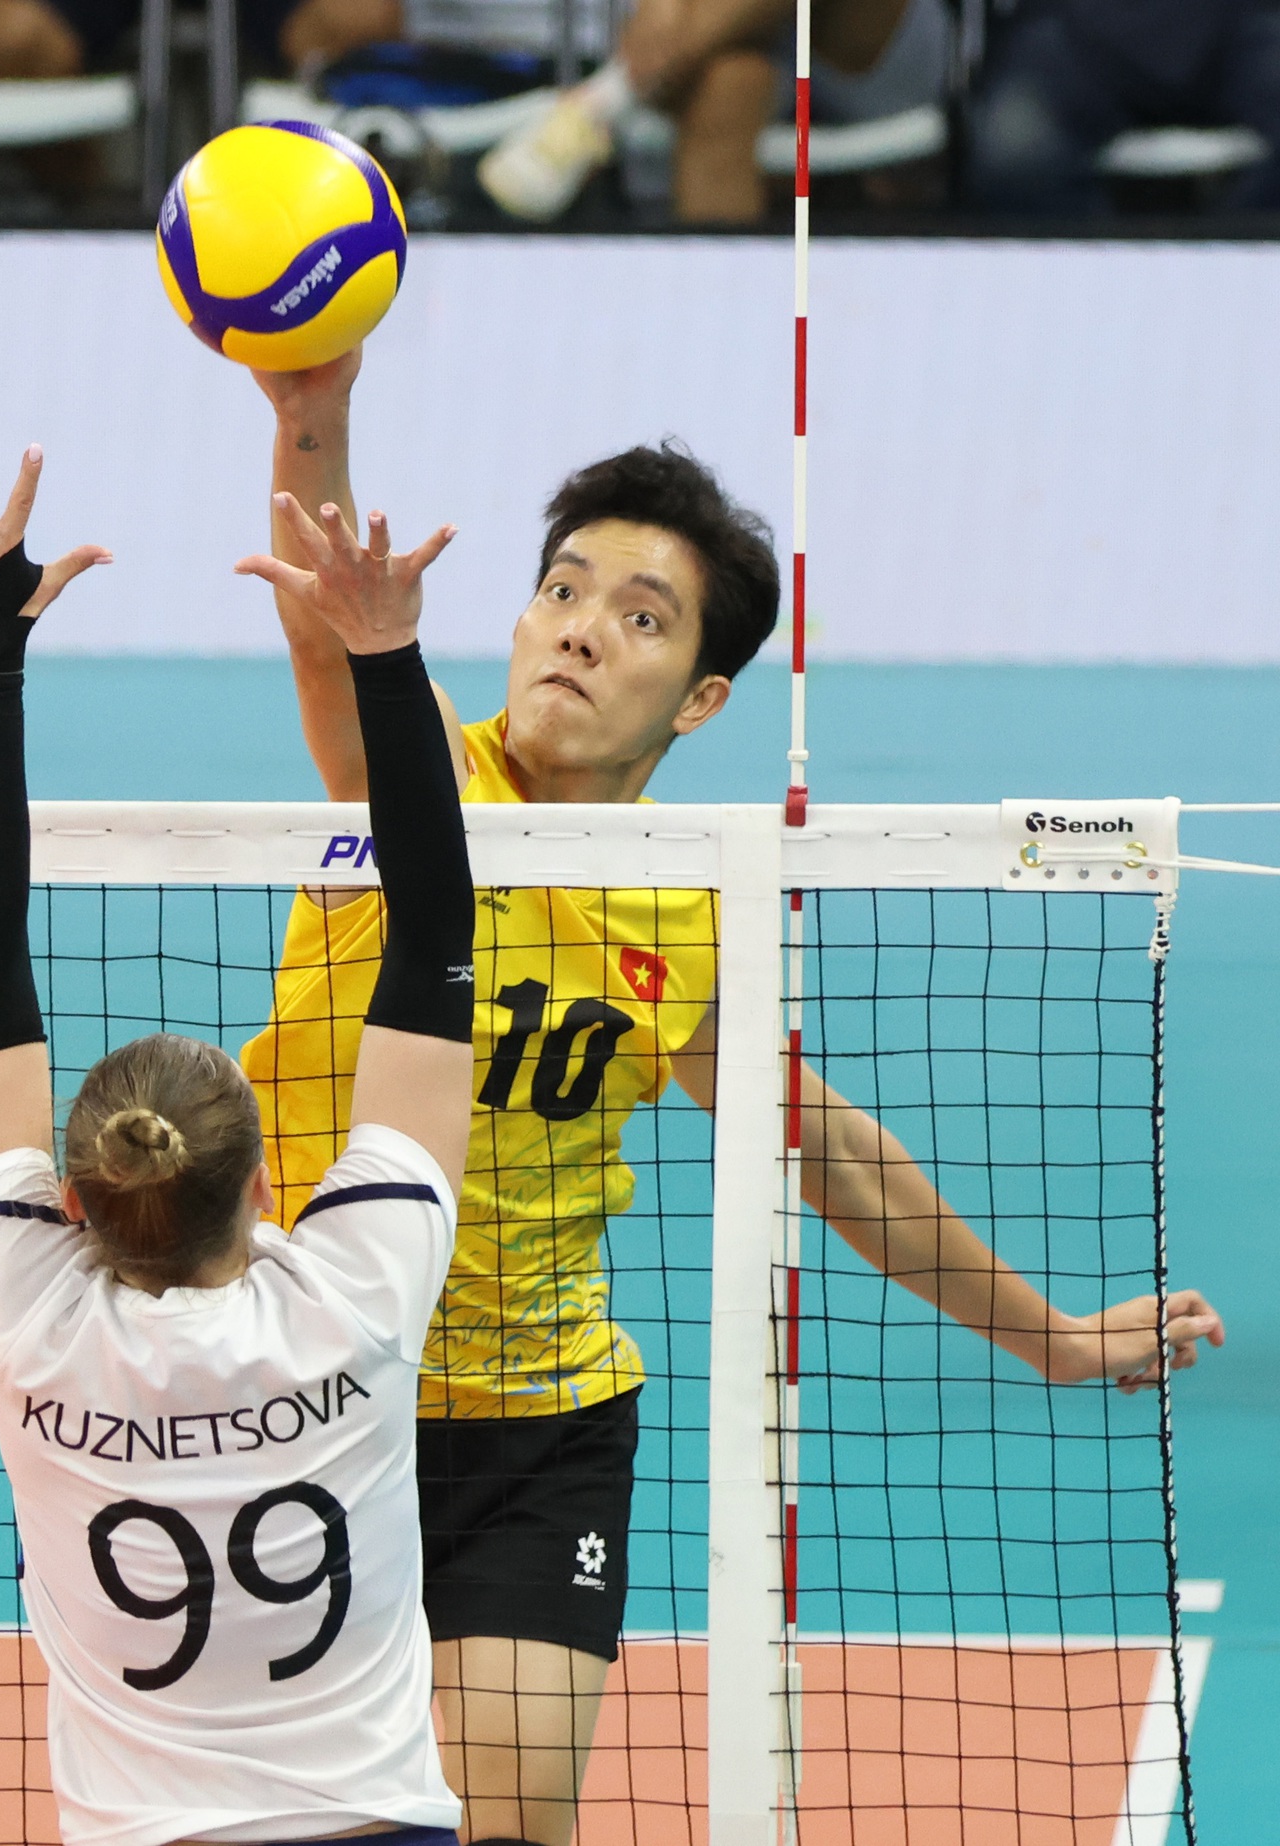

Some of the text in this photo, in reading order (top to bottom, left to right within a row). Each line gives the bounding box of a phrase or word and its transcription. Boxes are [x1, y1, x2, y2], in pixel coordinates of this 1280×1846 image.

[320, 835, 379, 868] PN
[1050, 816, 1133, 833] Senoh
[477, 977, 635, 1121] 10
[22, 1371, 371, 1462] KUZNETSOVA
[88, 1481, 352, 1692] 99
